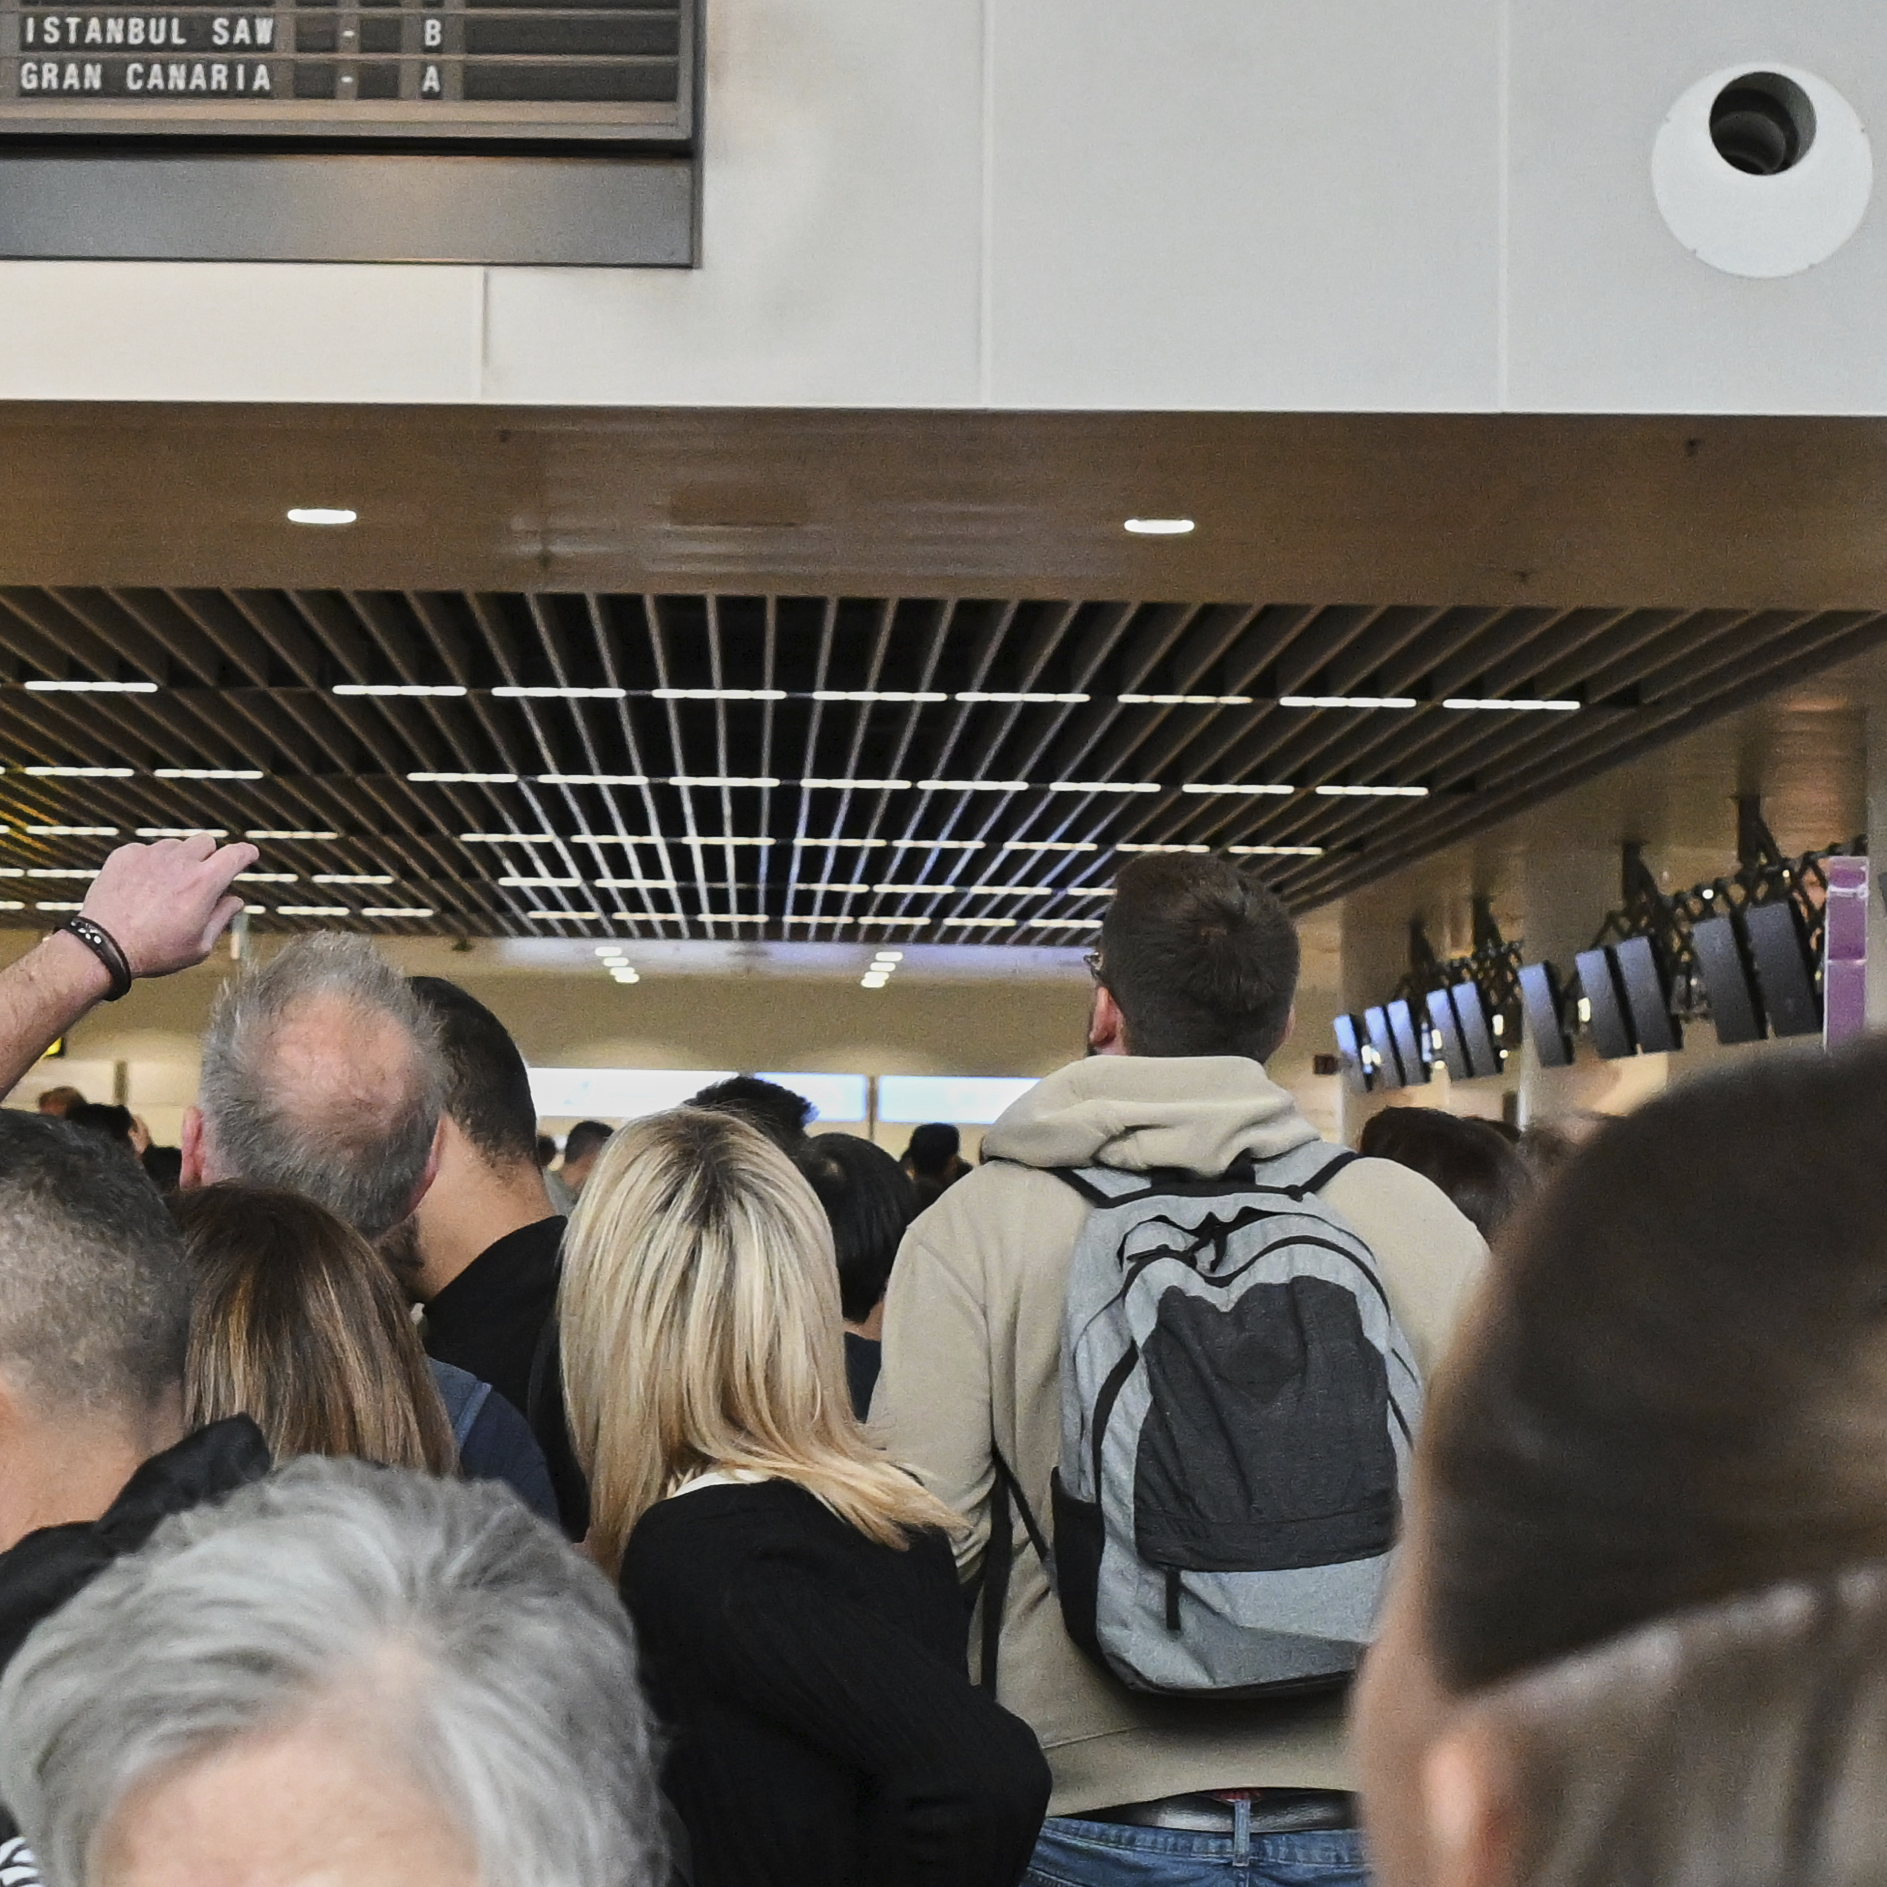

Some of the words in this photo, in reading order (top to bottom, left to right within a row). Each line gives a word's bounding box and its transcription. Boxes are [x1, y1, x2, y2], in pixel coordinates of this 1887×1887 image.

[27, 16, 186, 44] ISTANBUL
[21, 62, 101, 89] GRAN
[127, 63, 270, 90] CANARIA
